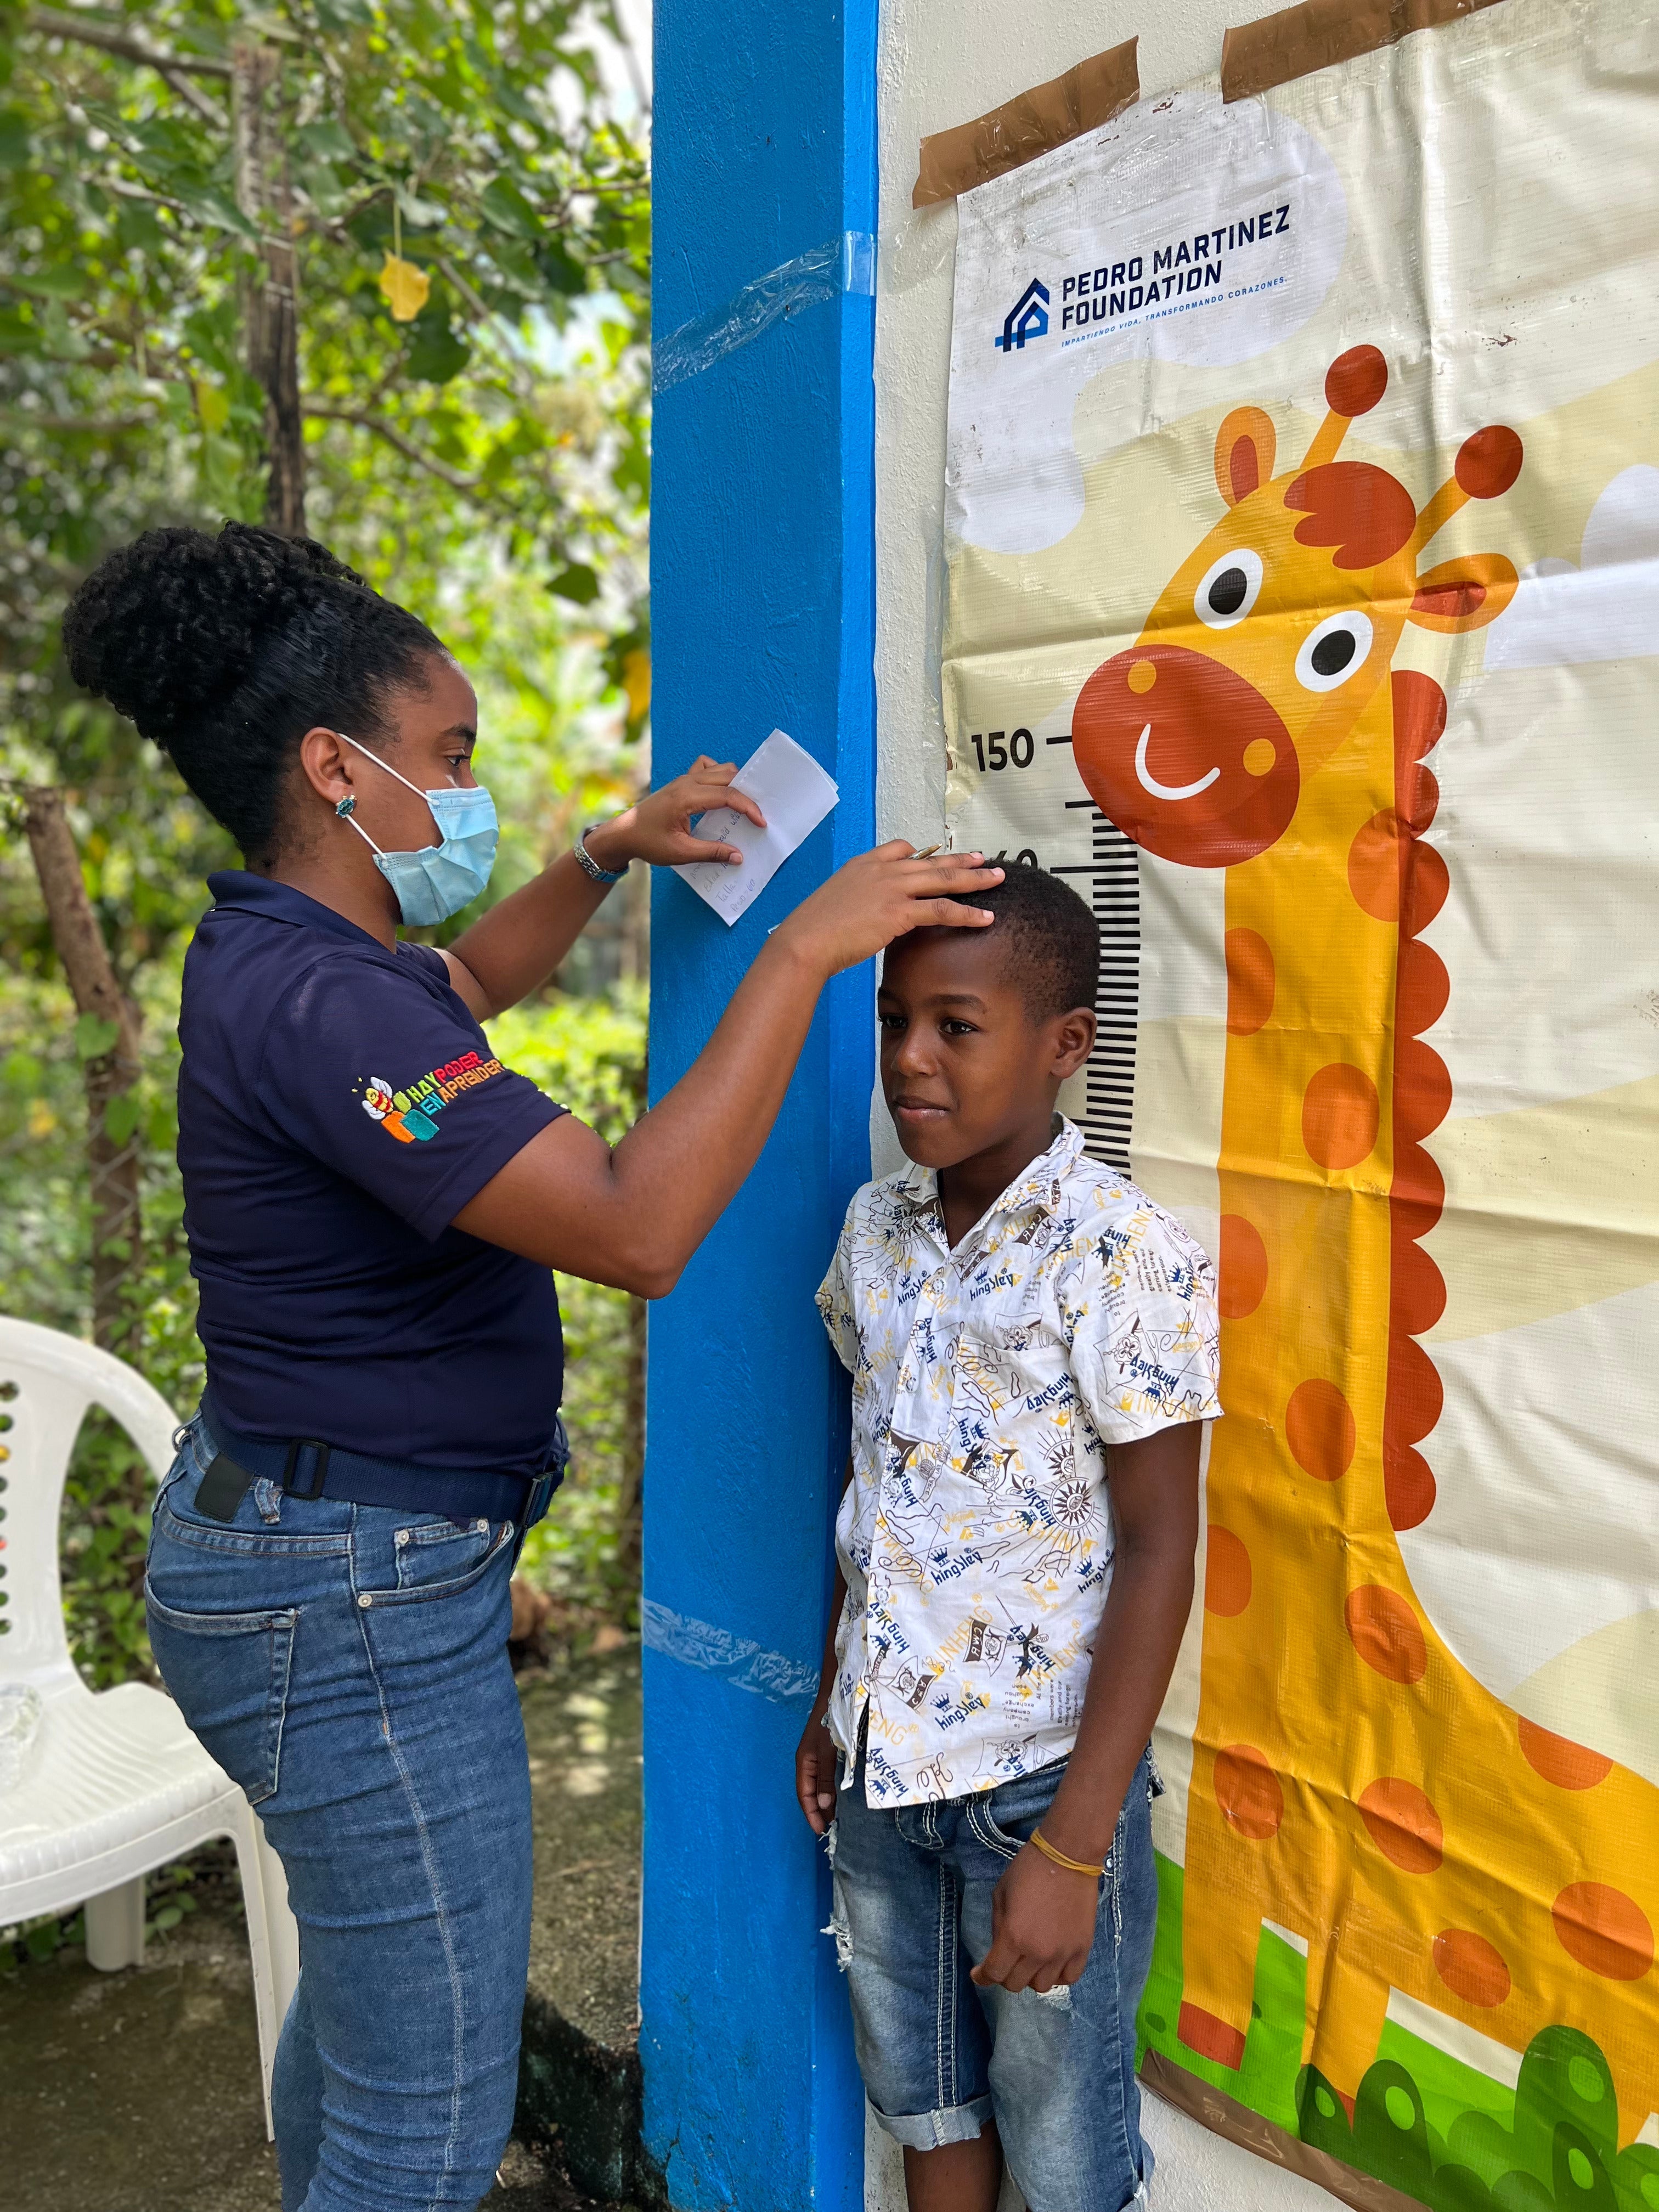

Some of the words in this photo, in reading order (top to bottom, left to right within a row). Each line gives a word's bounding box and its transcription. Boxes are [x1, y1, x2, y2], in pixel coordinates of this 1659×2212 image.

[1063, 256, 1142, 301] PEDRO
[1153, 204, 1290, 274] MARTINEZ
[1062, 260, 1222, 330] FOUNDATION
[1062, 326, 1115, 347] IMPARTIENDO
[1119, 318, 1142, 330] VIDA,
[1145, 294, 1224, 321] TRANSFORMANDO
[972, 728, 1034, 772] 150
